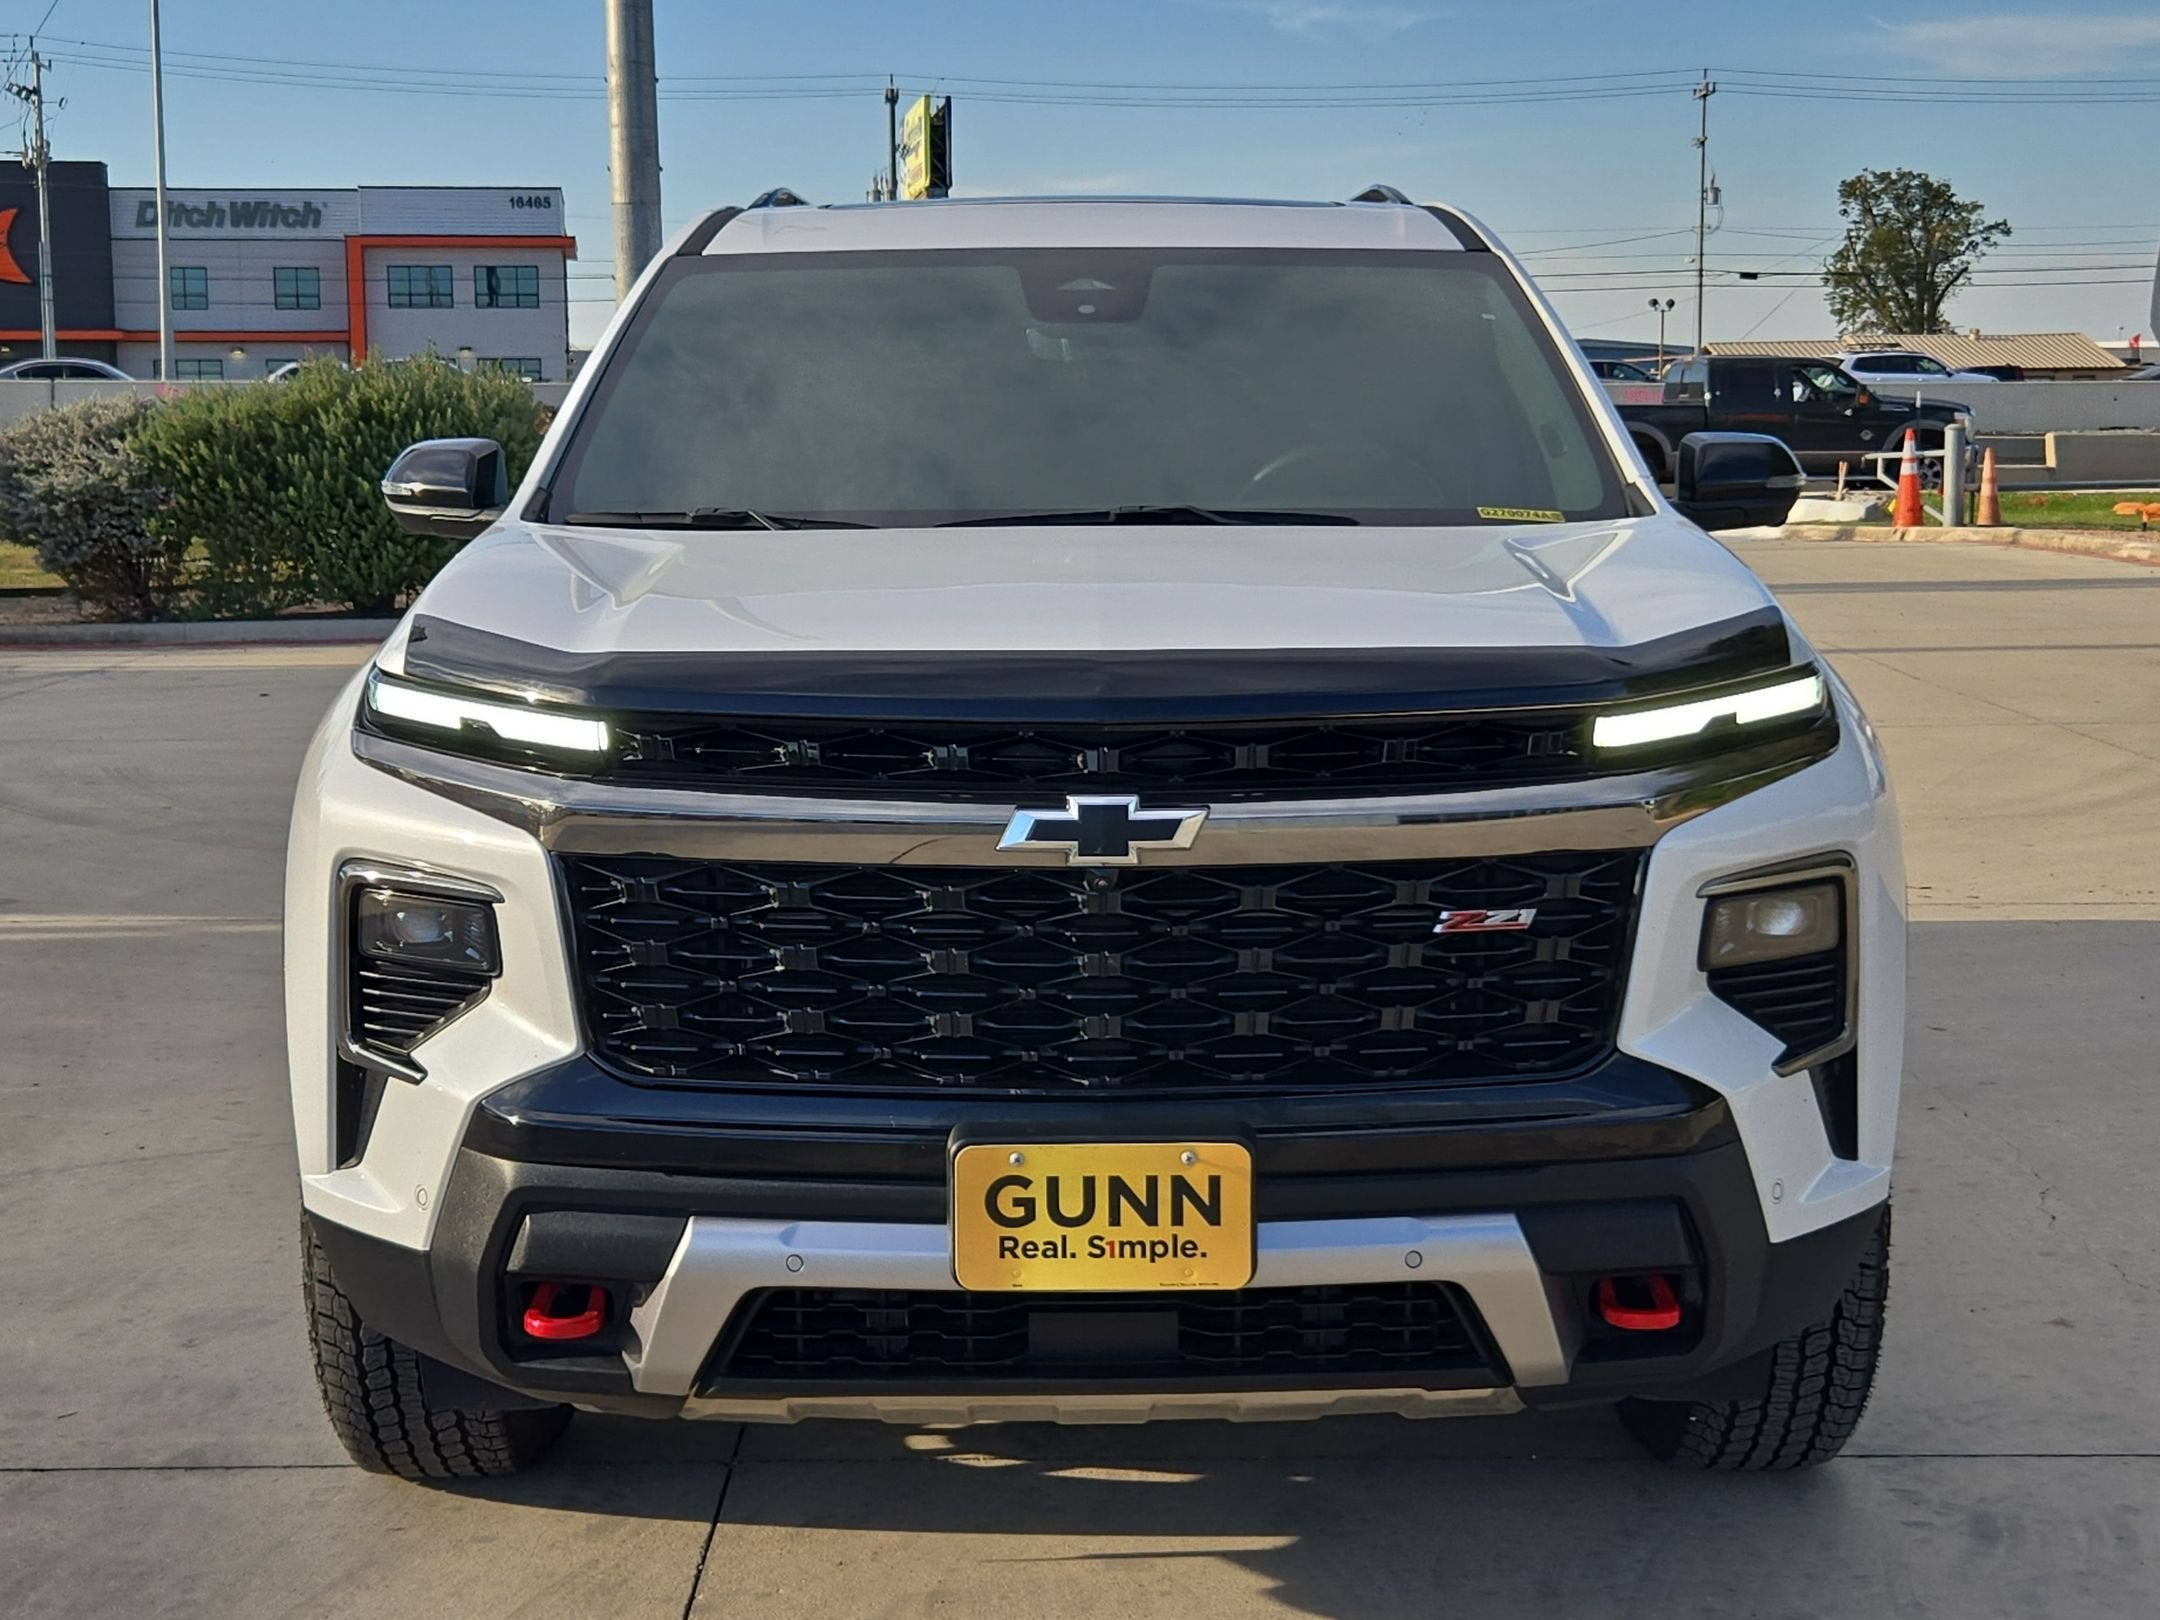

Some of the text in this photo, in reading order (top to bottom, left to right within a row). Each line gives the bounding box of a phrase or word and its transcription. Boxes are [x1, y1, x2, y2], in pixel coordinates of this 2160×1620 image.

[135, 201, 226, 228] Ditch
[509, 195, 552, 209] 16465
[1432, 908, 1537, 932] Z71
[984, 1174, 1222, 1229] GUNN
[998, 1234, 1077, 1259] Real.
